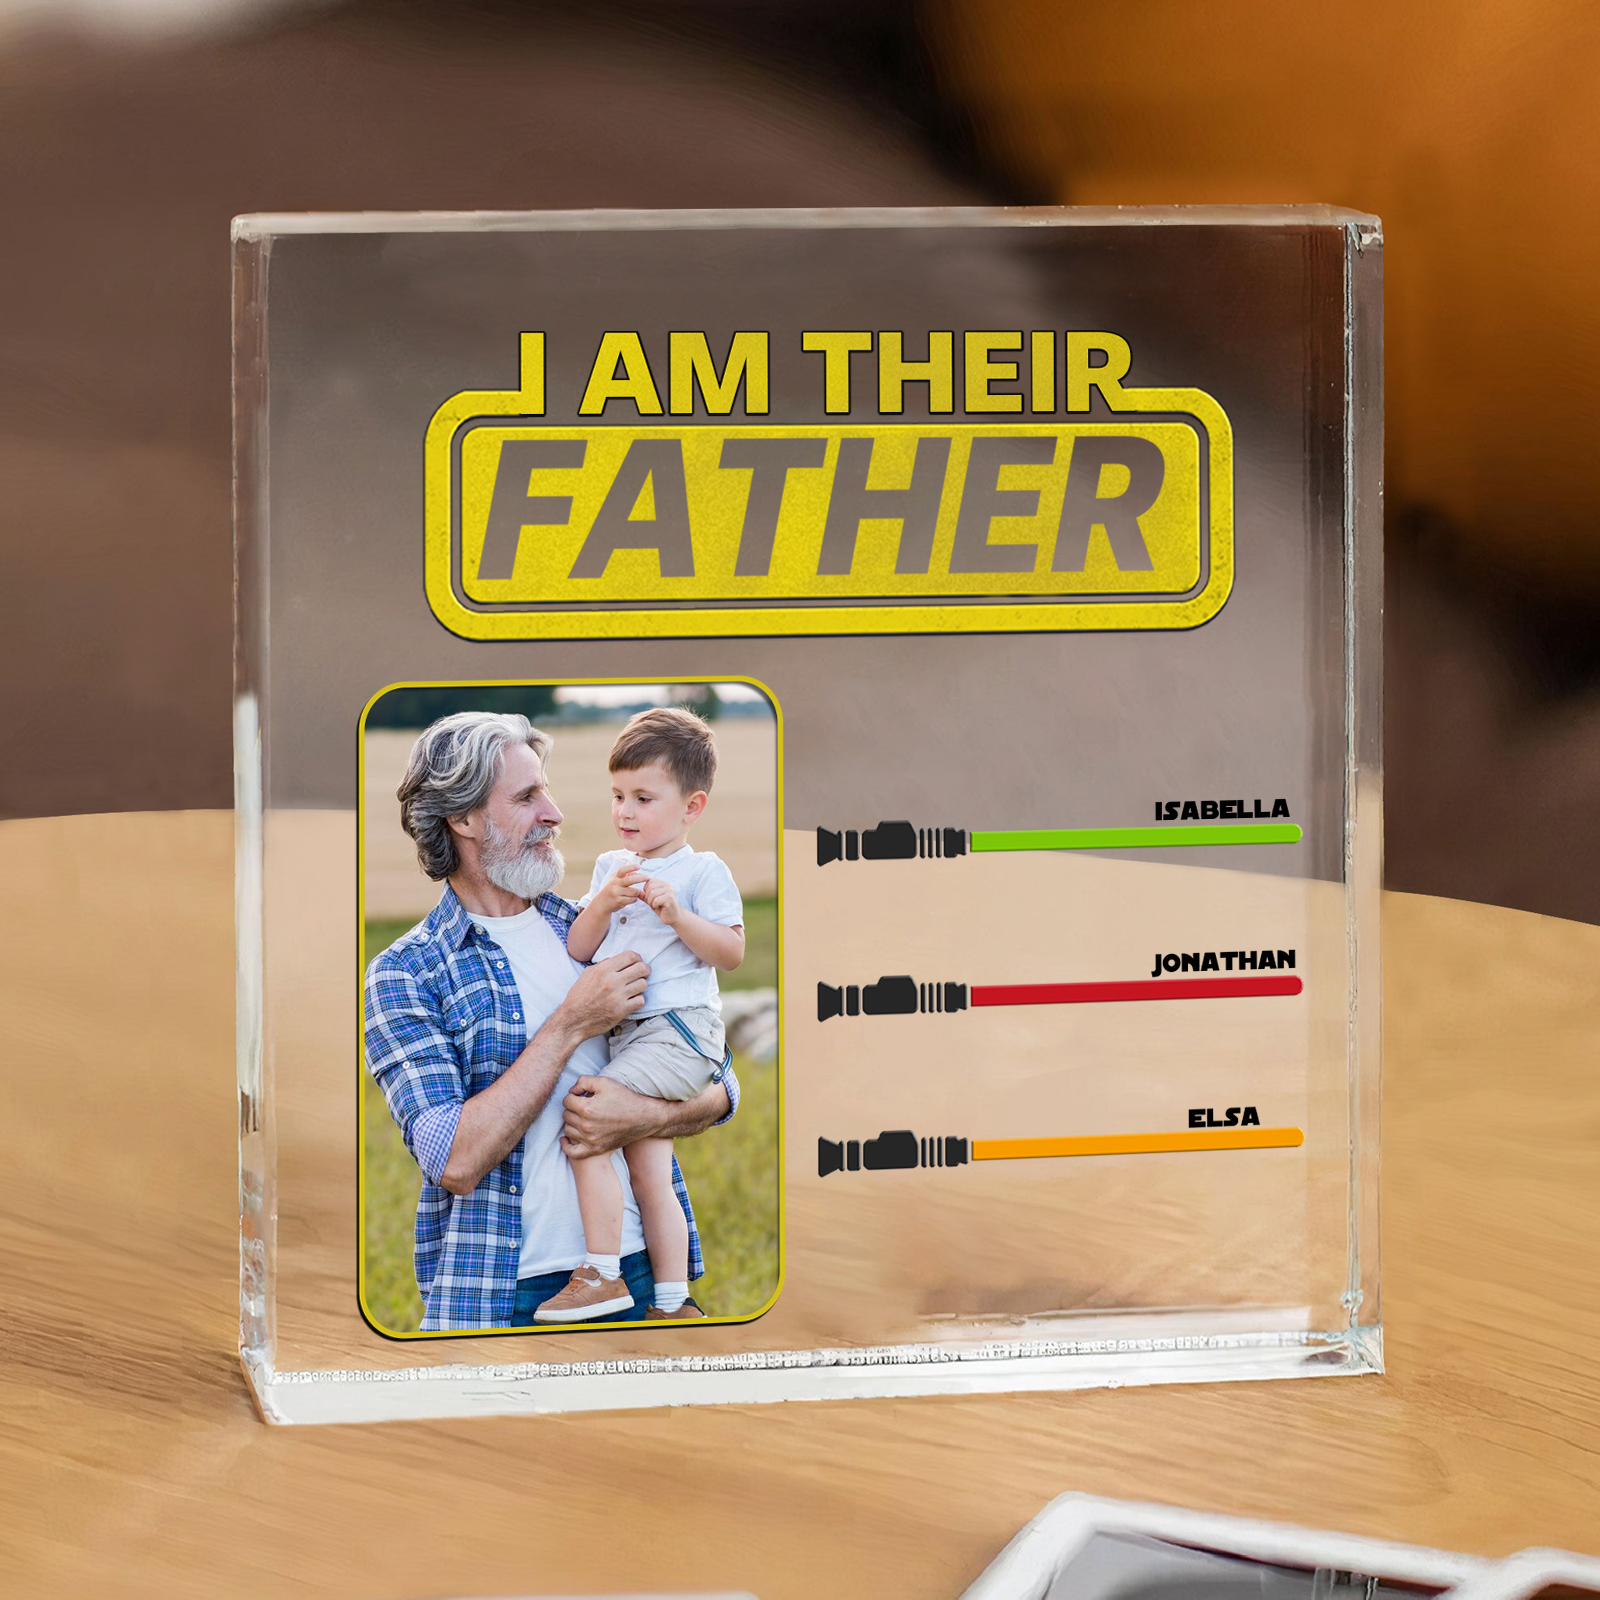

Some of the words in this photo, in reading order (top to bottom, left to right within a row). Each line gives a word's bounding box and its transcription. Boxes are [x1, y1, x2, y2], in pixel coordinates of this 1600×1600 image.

[519, 331, 546, 415] I
[578, 331, 770, 415] AM
[801, 330, 1133, 415] THEIR
[476, 436, 1166, 580] FATHER
[1155, 798, 1290, 821] ISABELLA
[1151, 949, 1296, 978] JONATHAN
[1188, 1106, 1261, 1128] ELSA
